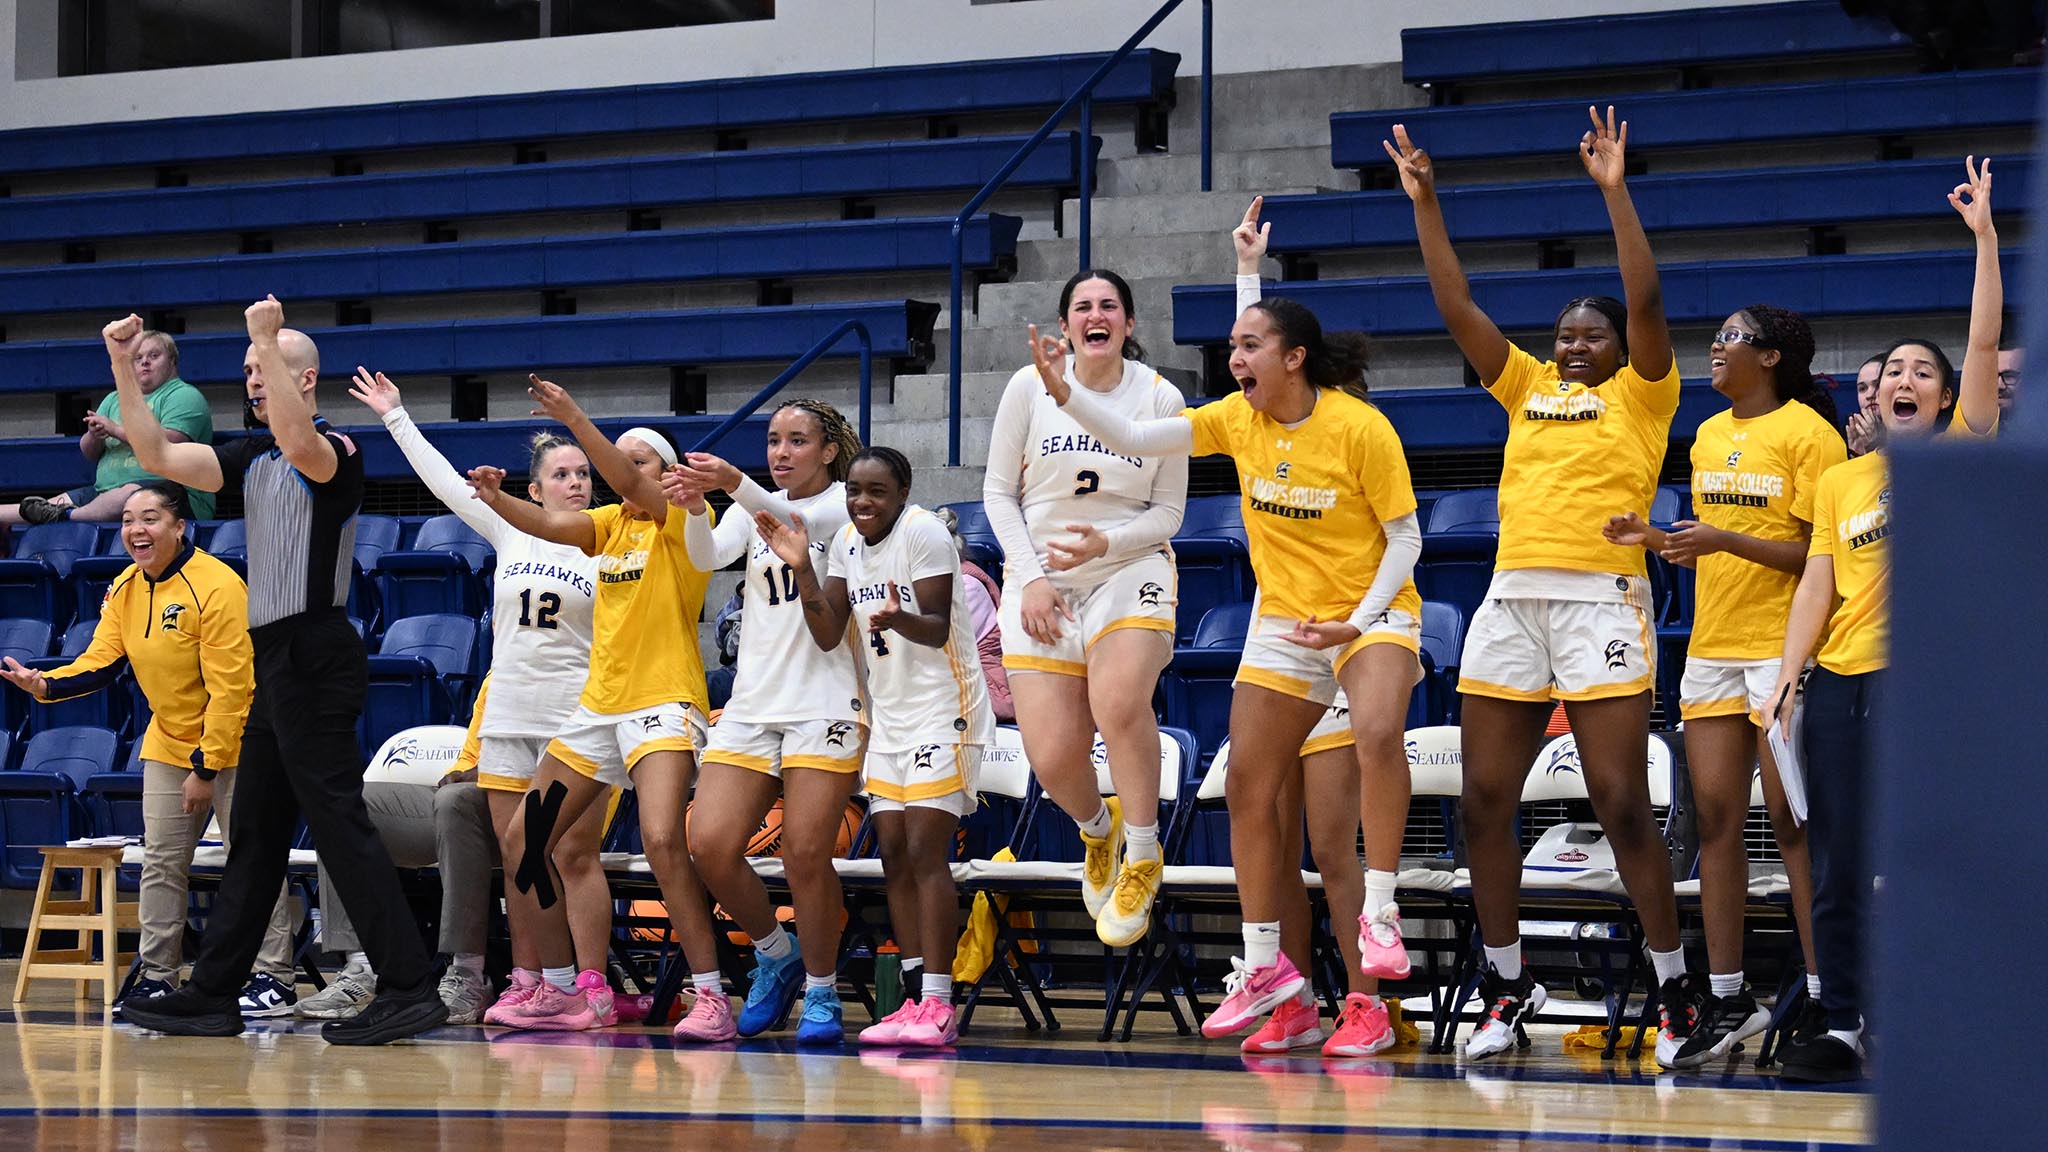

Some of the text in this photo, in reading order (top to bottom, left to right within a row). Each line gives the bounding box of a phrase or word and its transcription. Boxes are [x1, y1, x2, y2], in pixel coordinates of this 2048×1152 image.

[1074, 469, 1100, 496] 2
[1702, 471, 1737, 493] MARY'S
[1737, 472, 1784, 498] COLLEGE
[1250, 499, 1323, 520] ASKETBALL
[1289, 486, 1338, 510] COLLEGE
[1701, 493, 1767, 507] BASKETBALL
[502, 562, 593, 598] SEAHAWKS
[763, 562, 800, 606] 10
[518, 587, 562, 630] 12
[870, 631, 890, 657] 4
